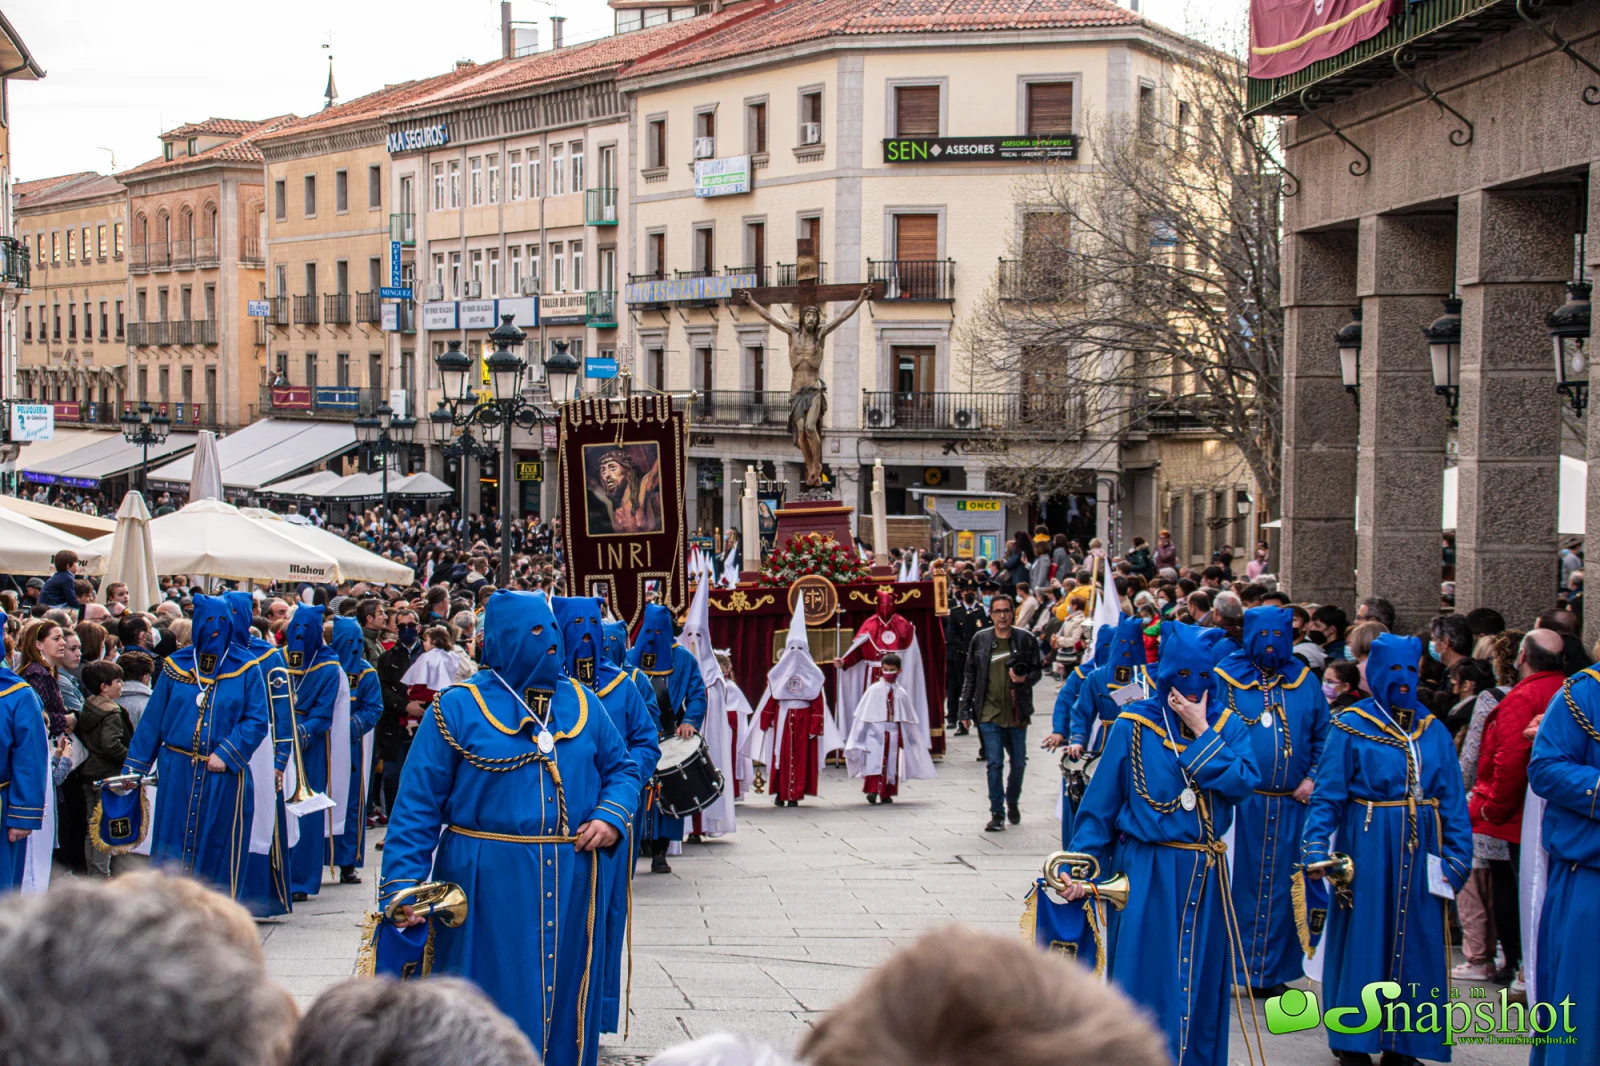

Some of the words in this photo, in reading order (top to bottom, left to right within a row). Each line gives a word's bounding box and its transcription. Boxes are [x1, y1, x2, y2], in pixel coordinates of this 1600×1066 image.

[386, 132, 404, 153] AXA
[405, 125, 443, 150] SEGUROS
[888, 141, 928, 160] SEN
[945, 144, 995, 155] ASESORES
[392, 243, 400, 288] OFICINAS
[381, 289, 412, 298] MINGUEZ
[626, 281, 699, 302] AUTO-ESCUELA
[542, 298, 558, 308] TALLER
[560, 297, 567, 307] DE
[17, 405, 47, 414] PELUQUERIA
[969, 502, 997, 510] ONCE
[597, 540, 652, 570] INRI
[289, 564, 325, 575] Mahou
